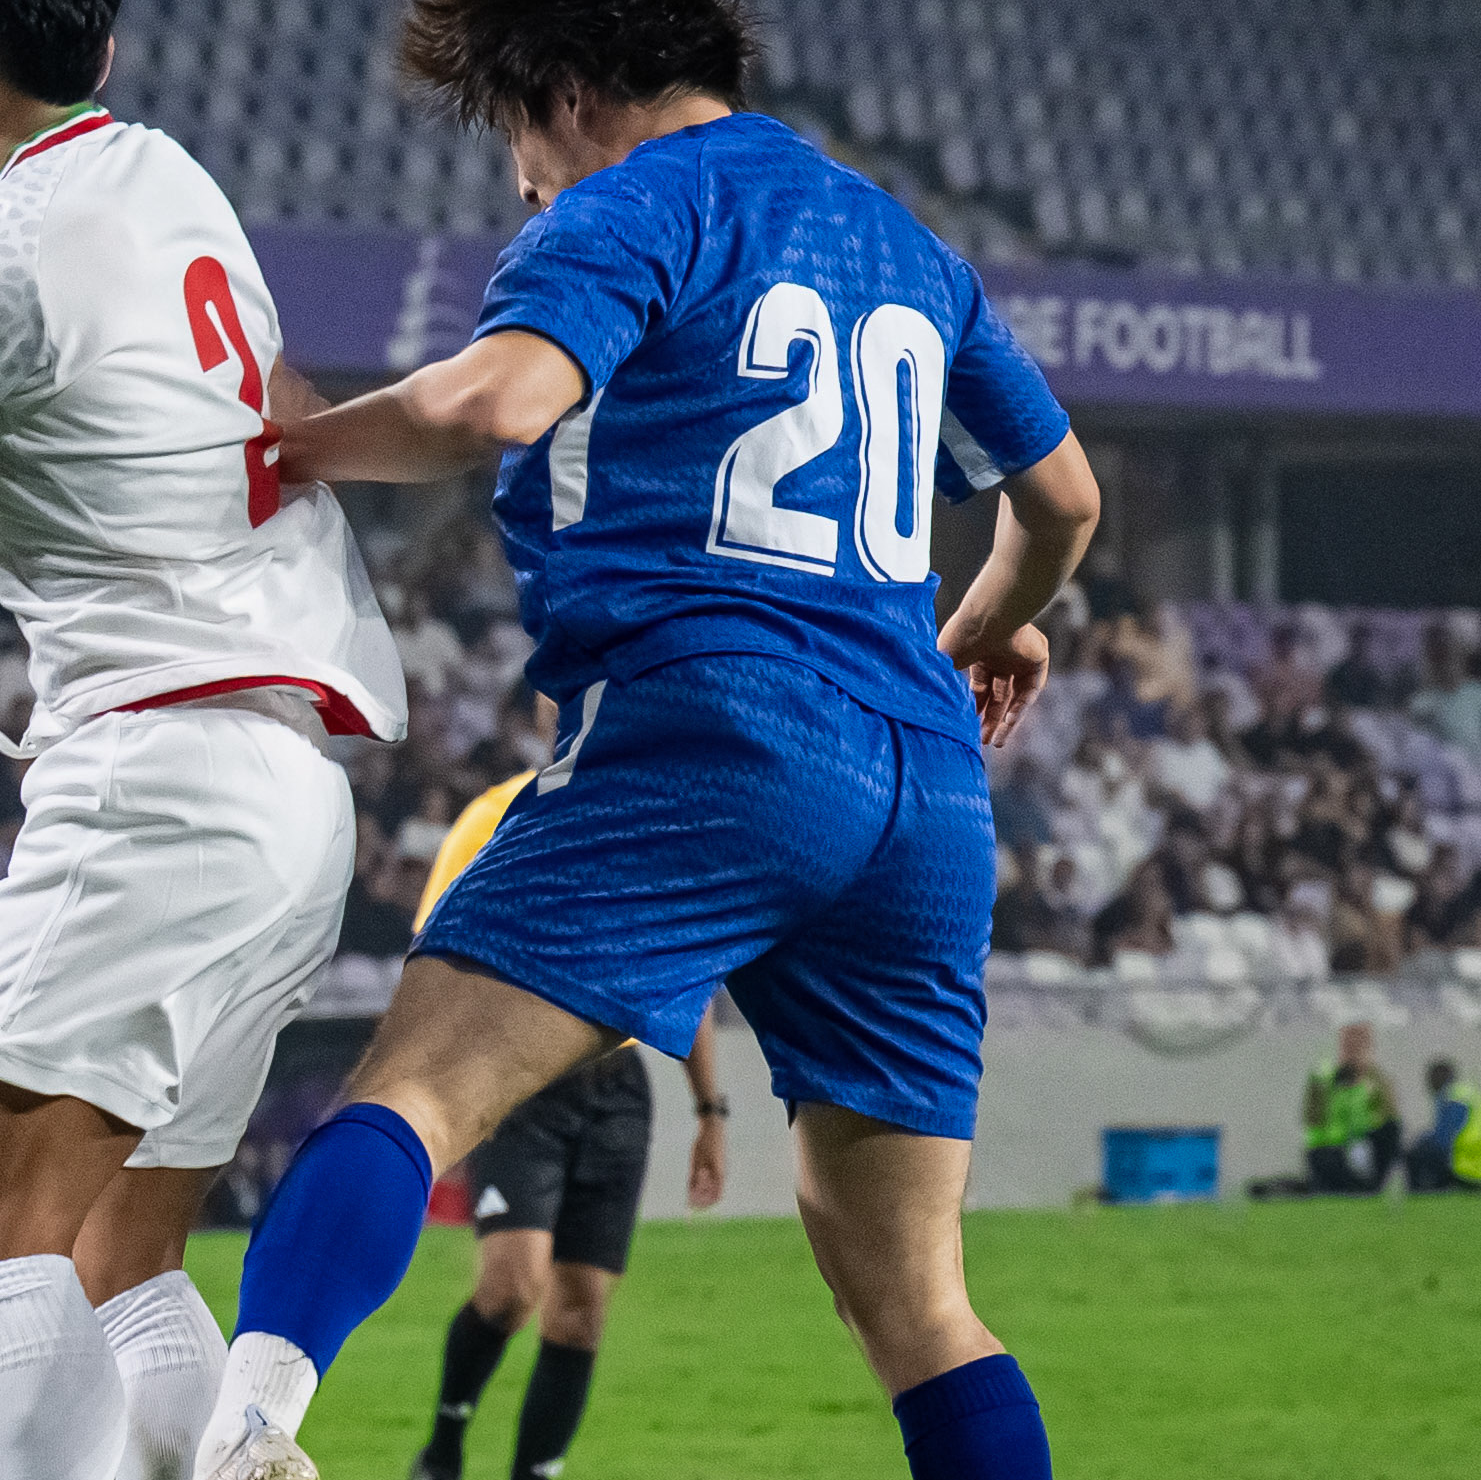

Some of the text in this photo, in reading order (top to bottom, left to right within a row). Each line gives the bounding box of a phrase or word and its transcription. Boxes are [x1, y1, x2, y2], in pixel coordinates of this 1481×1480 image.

[184, 255, 283, 529] 2
[706, 282, 945, 583] 20
[1076, 298, 1323, 380] FOOTBALL
